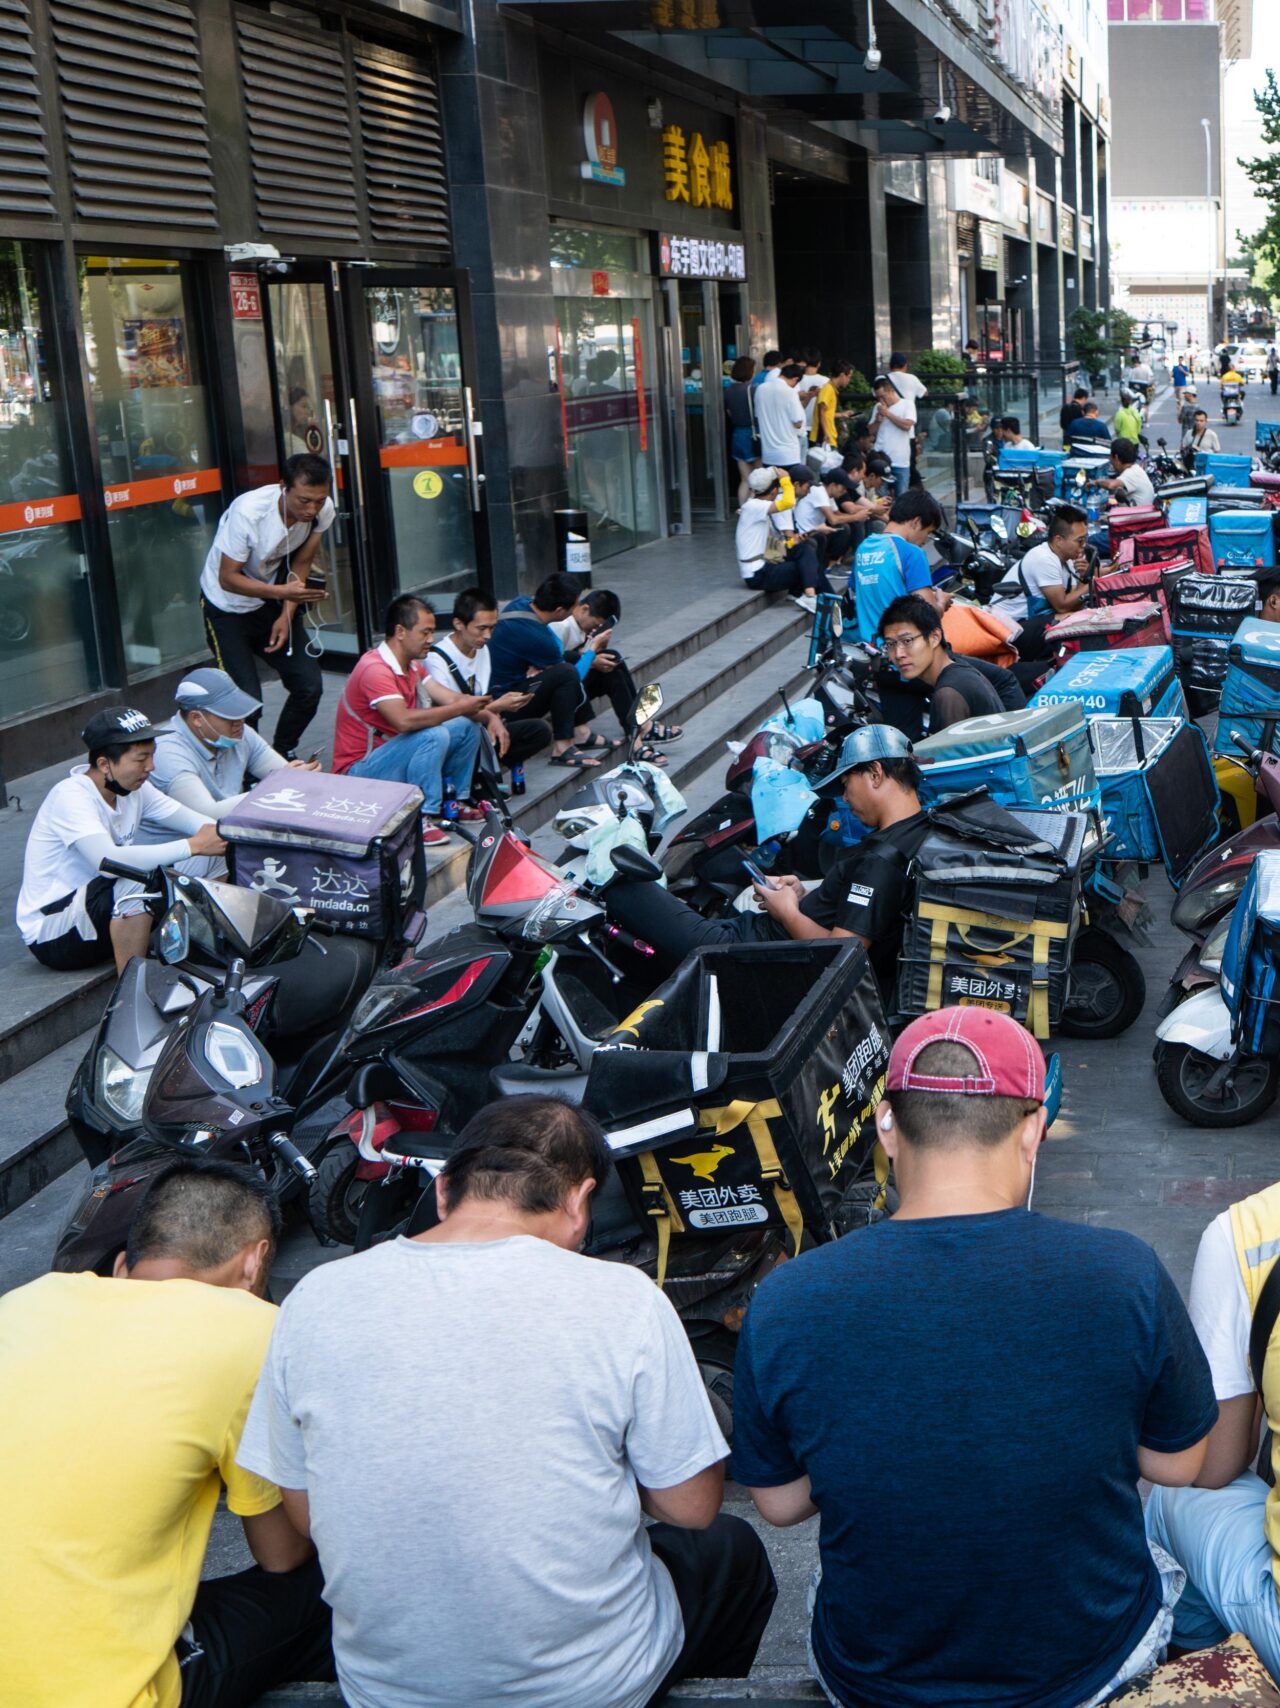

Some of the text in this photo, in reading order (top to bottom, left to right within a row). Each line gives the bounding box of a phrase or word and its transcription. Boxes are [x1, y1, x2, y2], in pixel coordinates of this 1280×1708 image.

[320, 797, 383, 817] 达达
[311, 866, 370, 898] 达达
[310, 897, 370, 912] imdada.cn
[842, 1022, 883, 1099] 美团跑腿
[679, 1184, 763, 1209] 美团外卖
[699, 1207, 759, 1225] 美团跑腿
